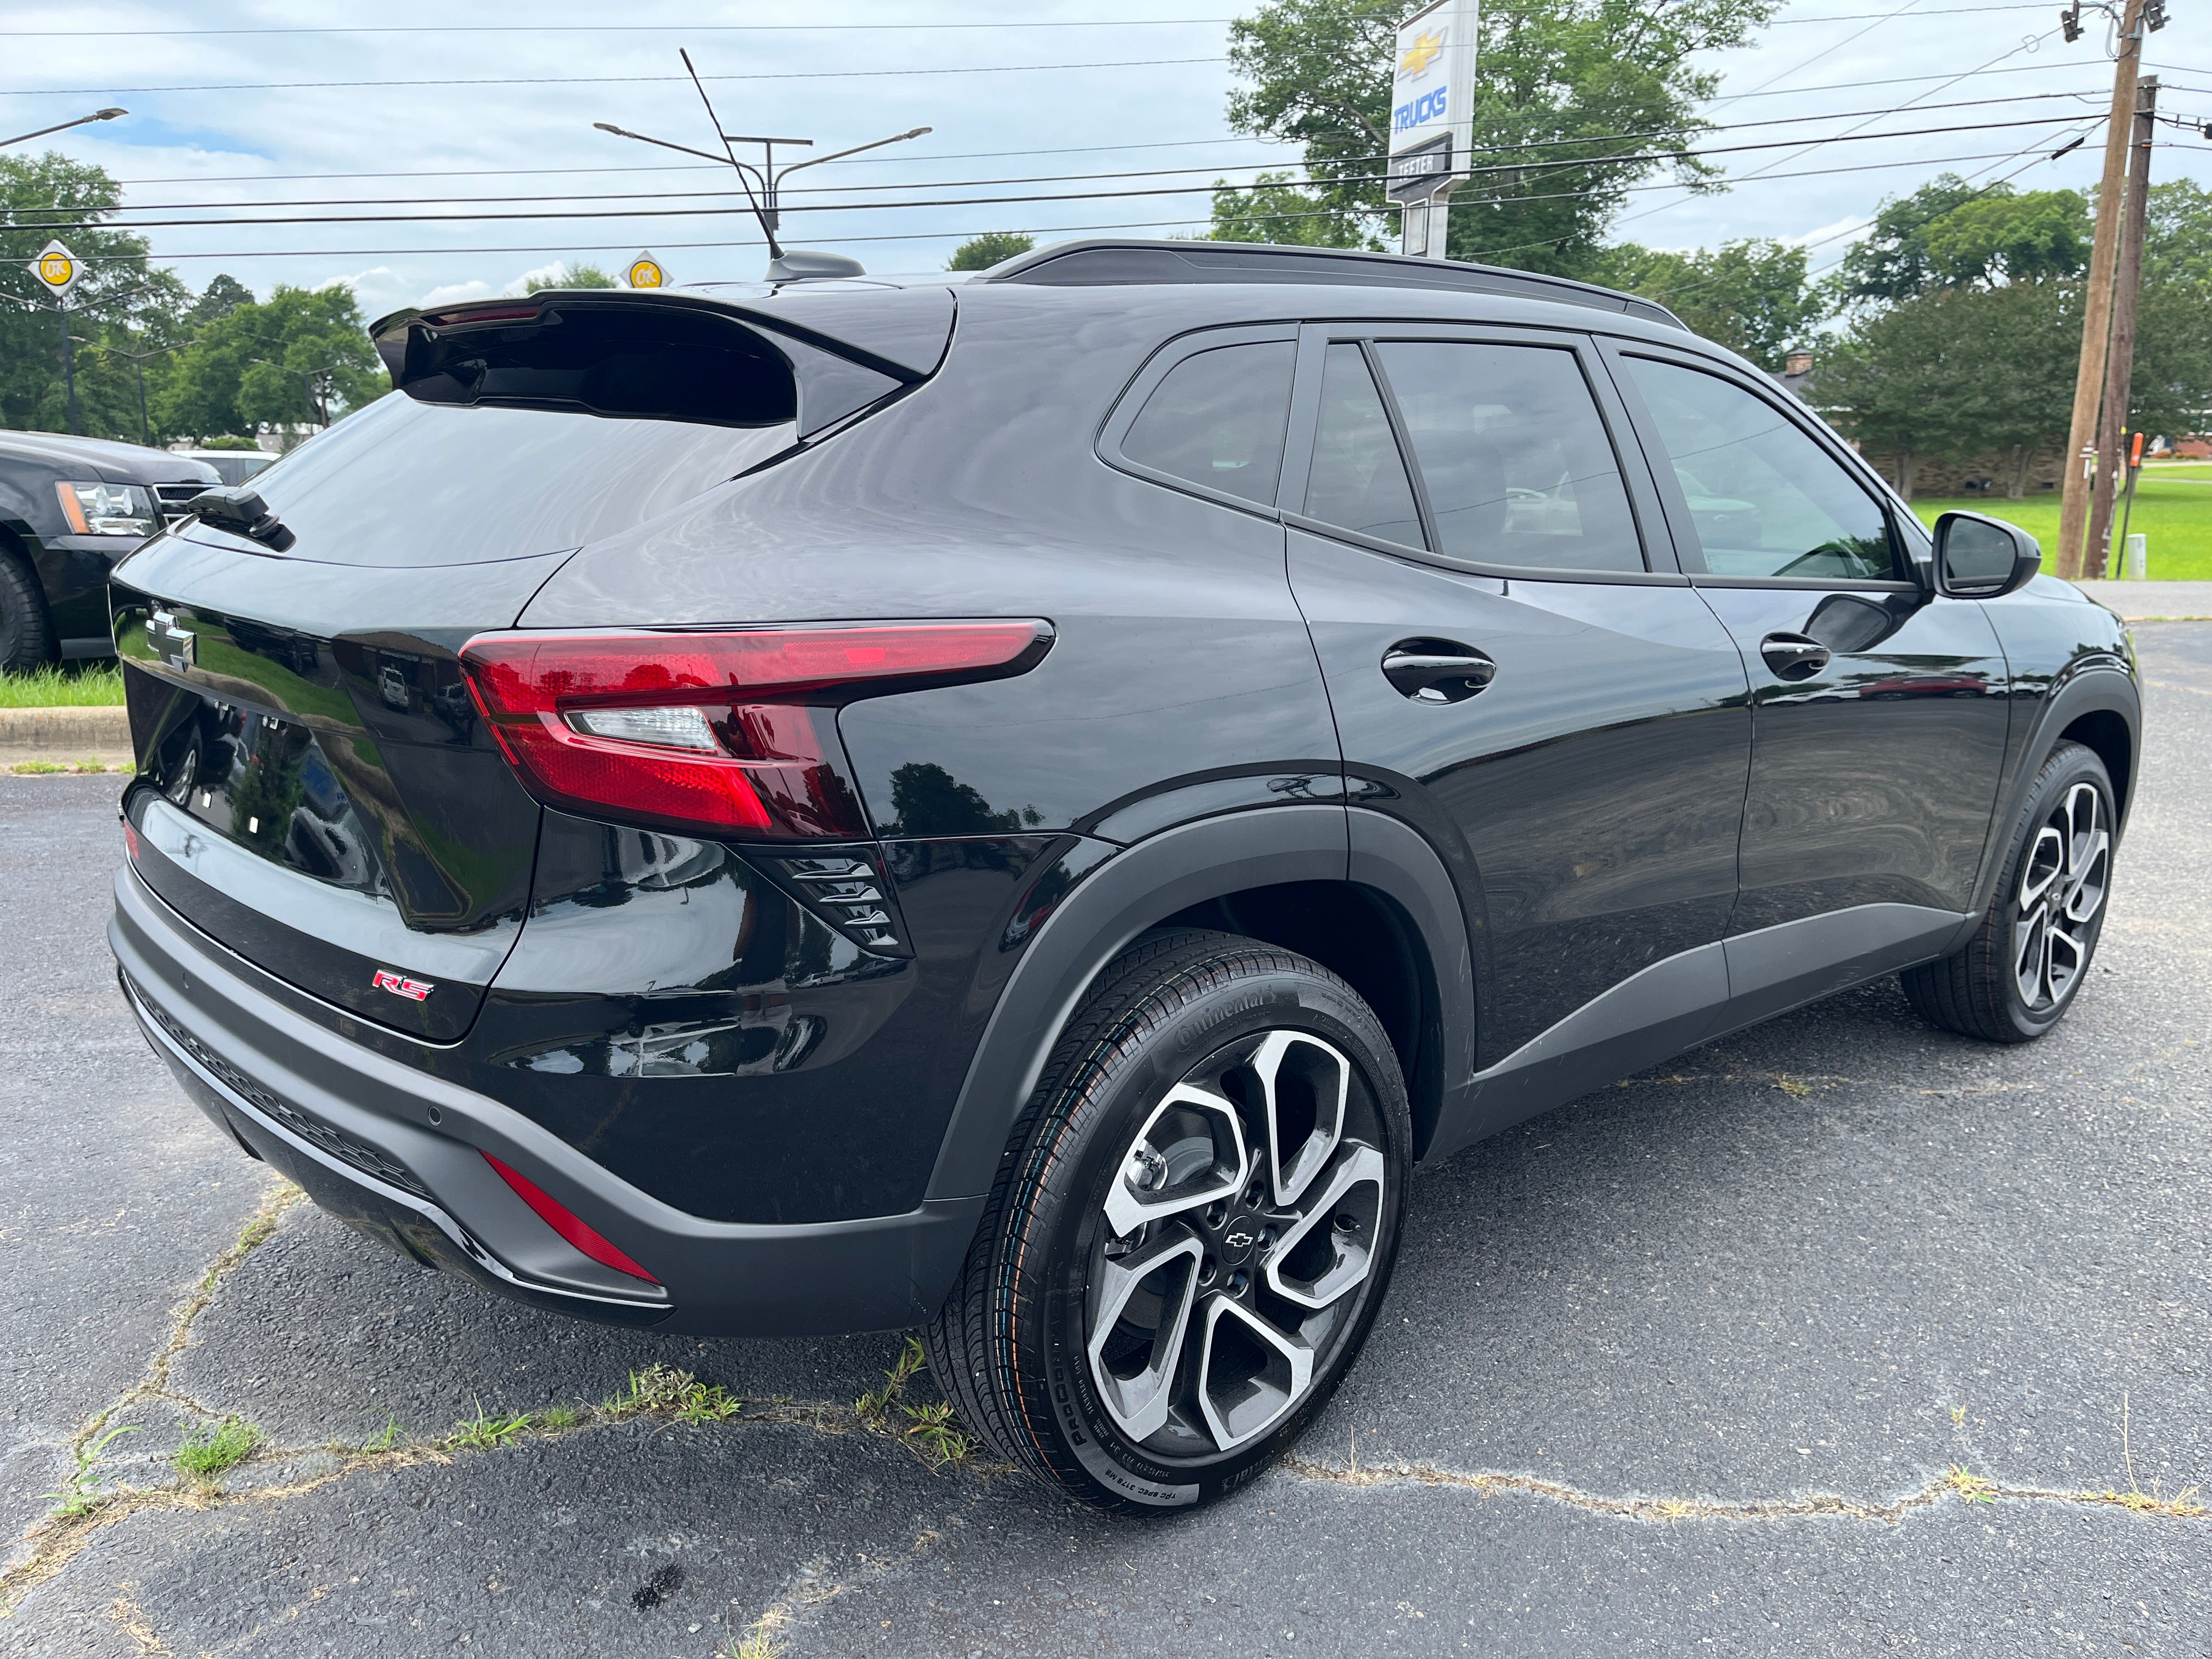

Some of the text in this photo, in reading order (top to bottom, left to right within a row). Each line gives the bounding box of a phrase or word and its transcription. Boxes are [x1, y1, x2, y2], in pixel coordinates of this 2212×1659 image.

[1394, 86, 1447, 134] TRUCKS
[46, 259, 67, 278] OK
[635, 266, 657, 285] OK
[373, 969, 434, 1001] RS
[1175, 987, 1263, 1052] Continental
[1138, 1487, 1158, 1497] SPEC.
